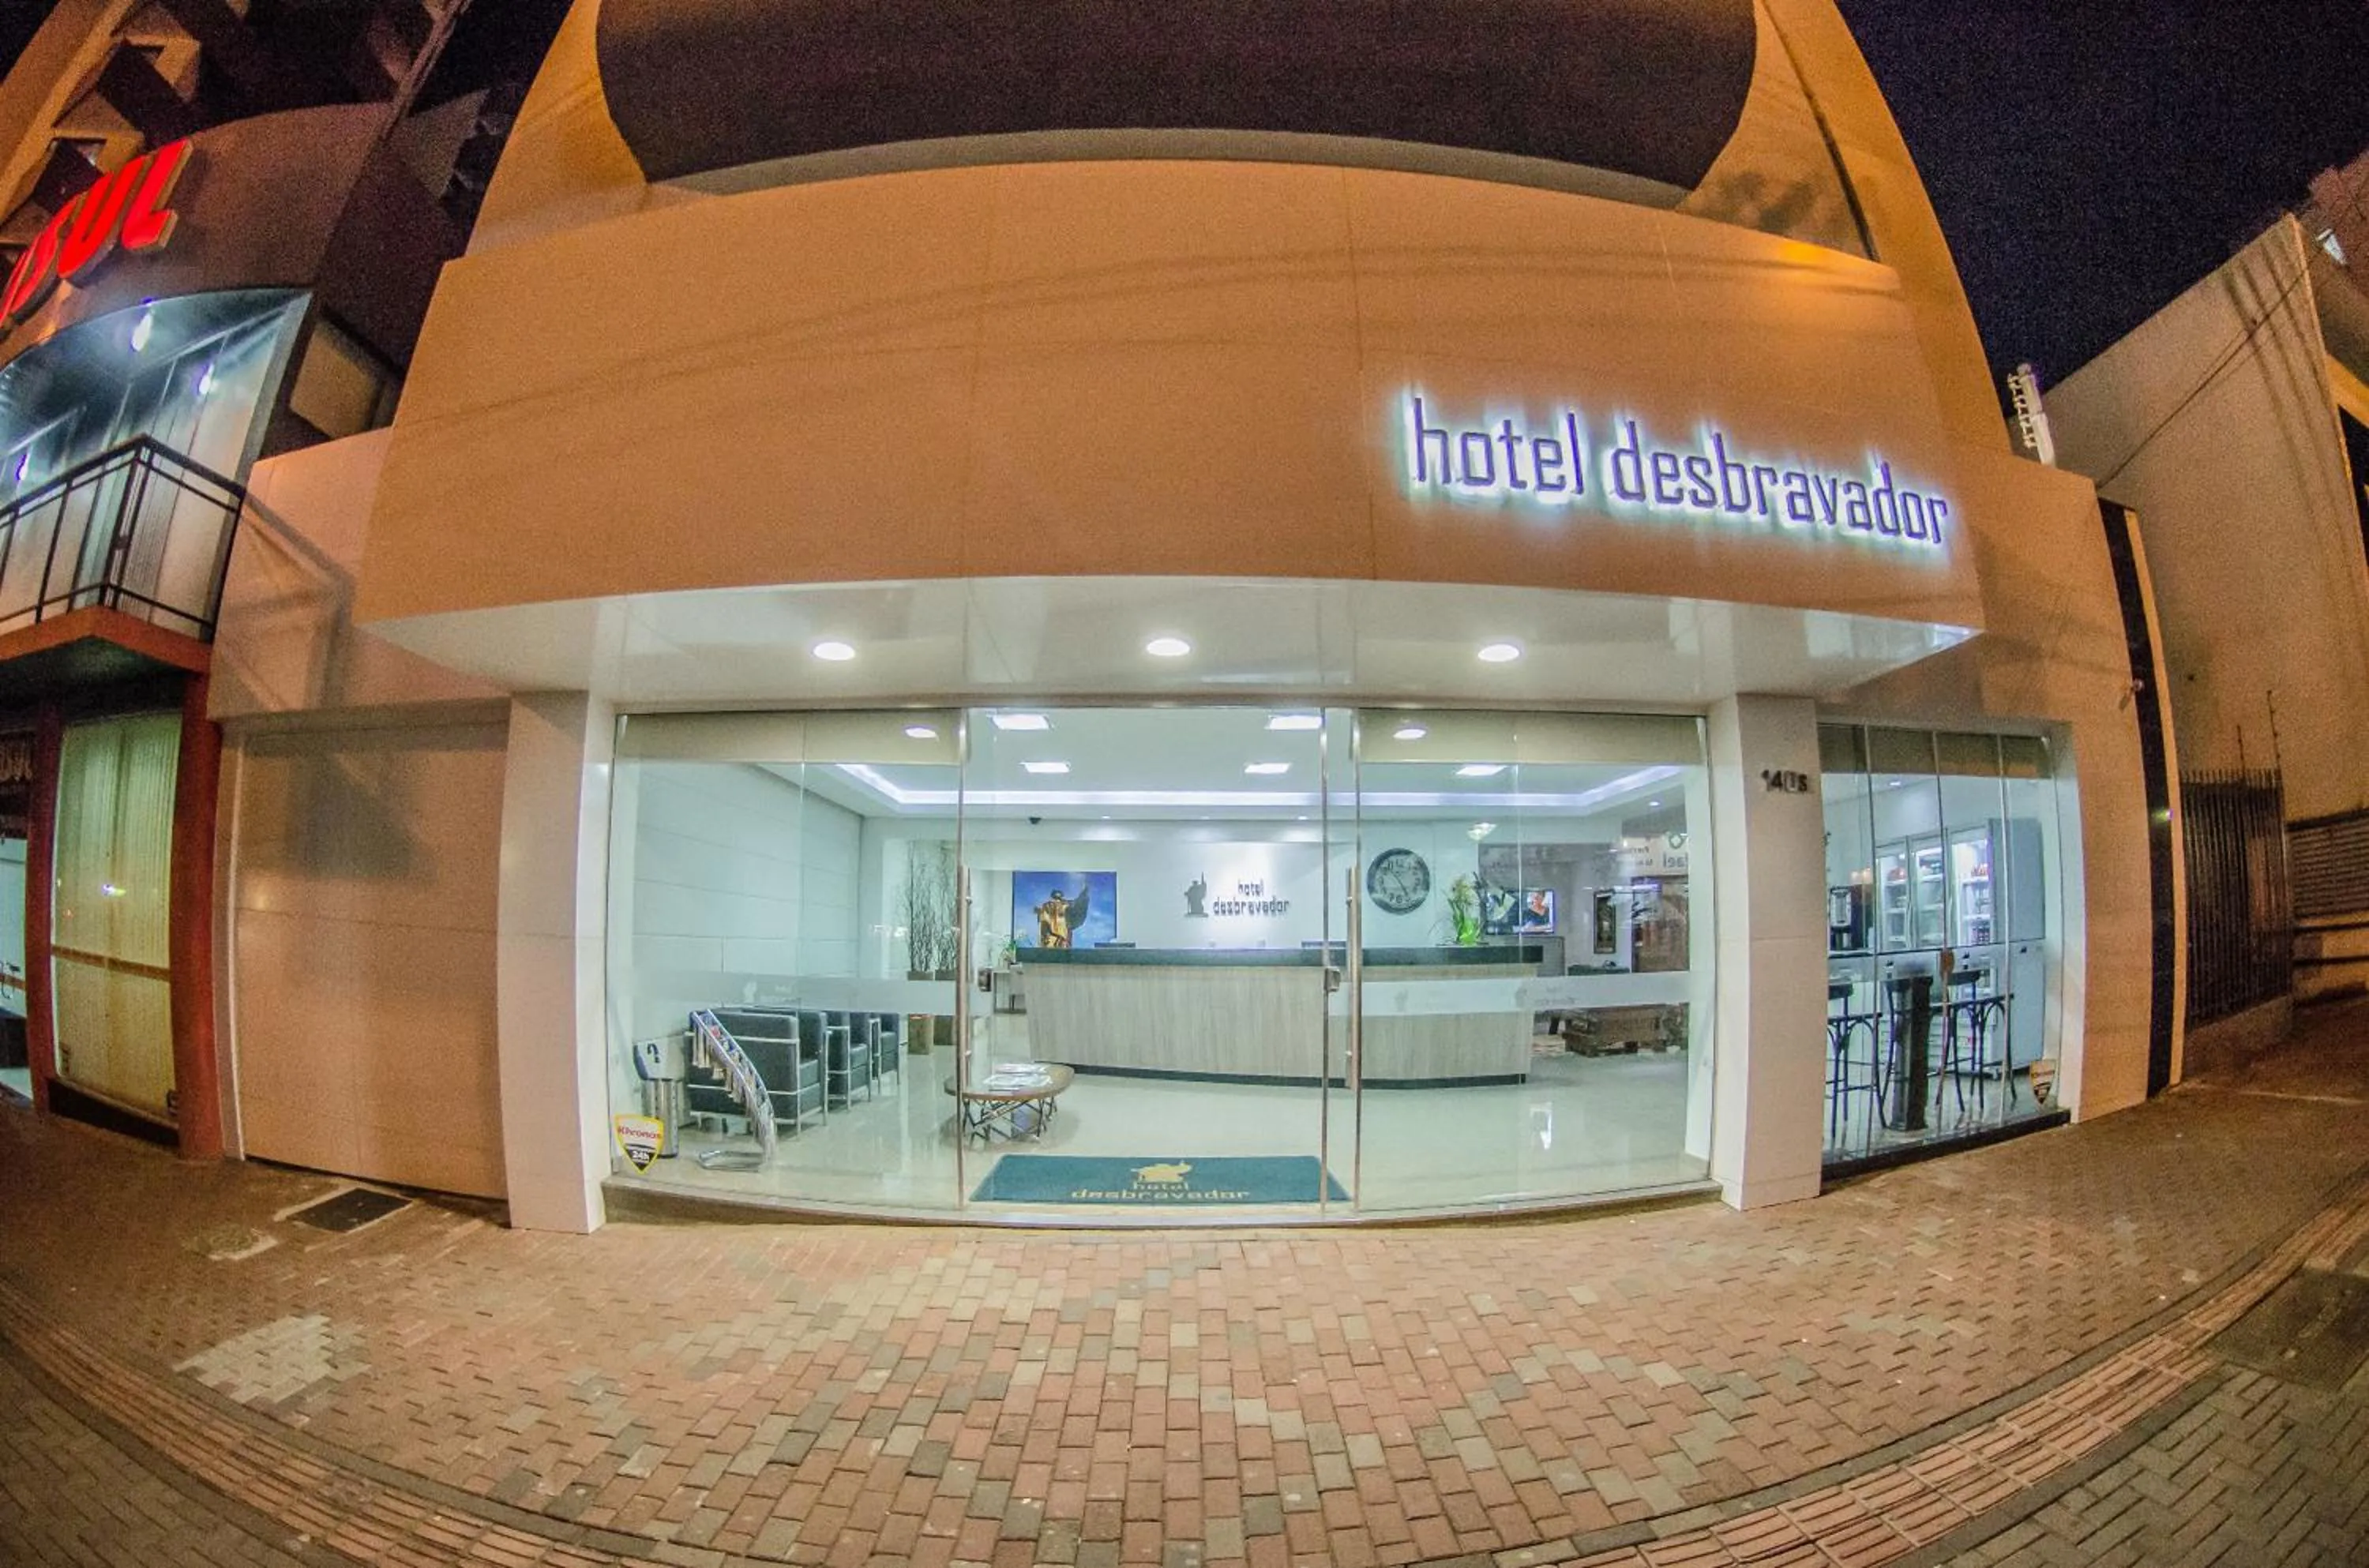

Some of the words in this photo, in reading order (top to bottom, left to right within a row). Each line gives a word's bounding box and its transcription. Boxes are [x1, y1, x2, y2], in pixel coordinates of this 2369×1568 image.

[1412, 396, 1584, 495] hotel
[1612, 419, 1949, 545] desbravador
[1237, 878, 1264, 896] hotel
[1212, 895, 1290, 916] desbravador
[1071, 1188, 1251, 1199] desbravador
[1132, 1181, 1189, 1191] hotel
